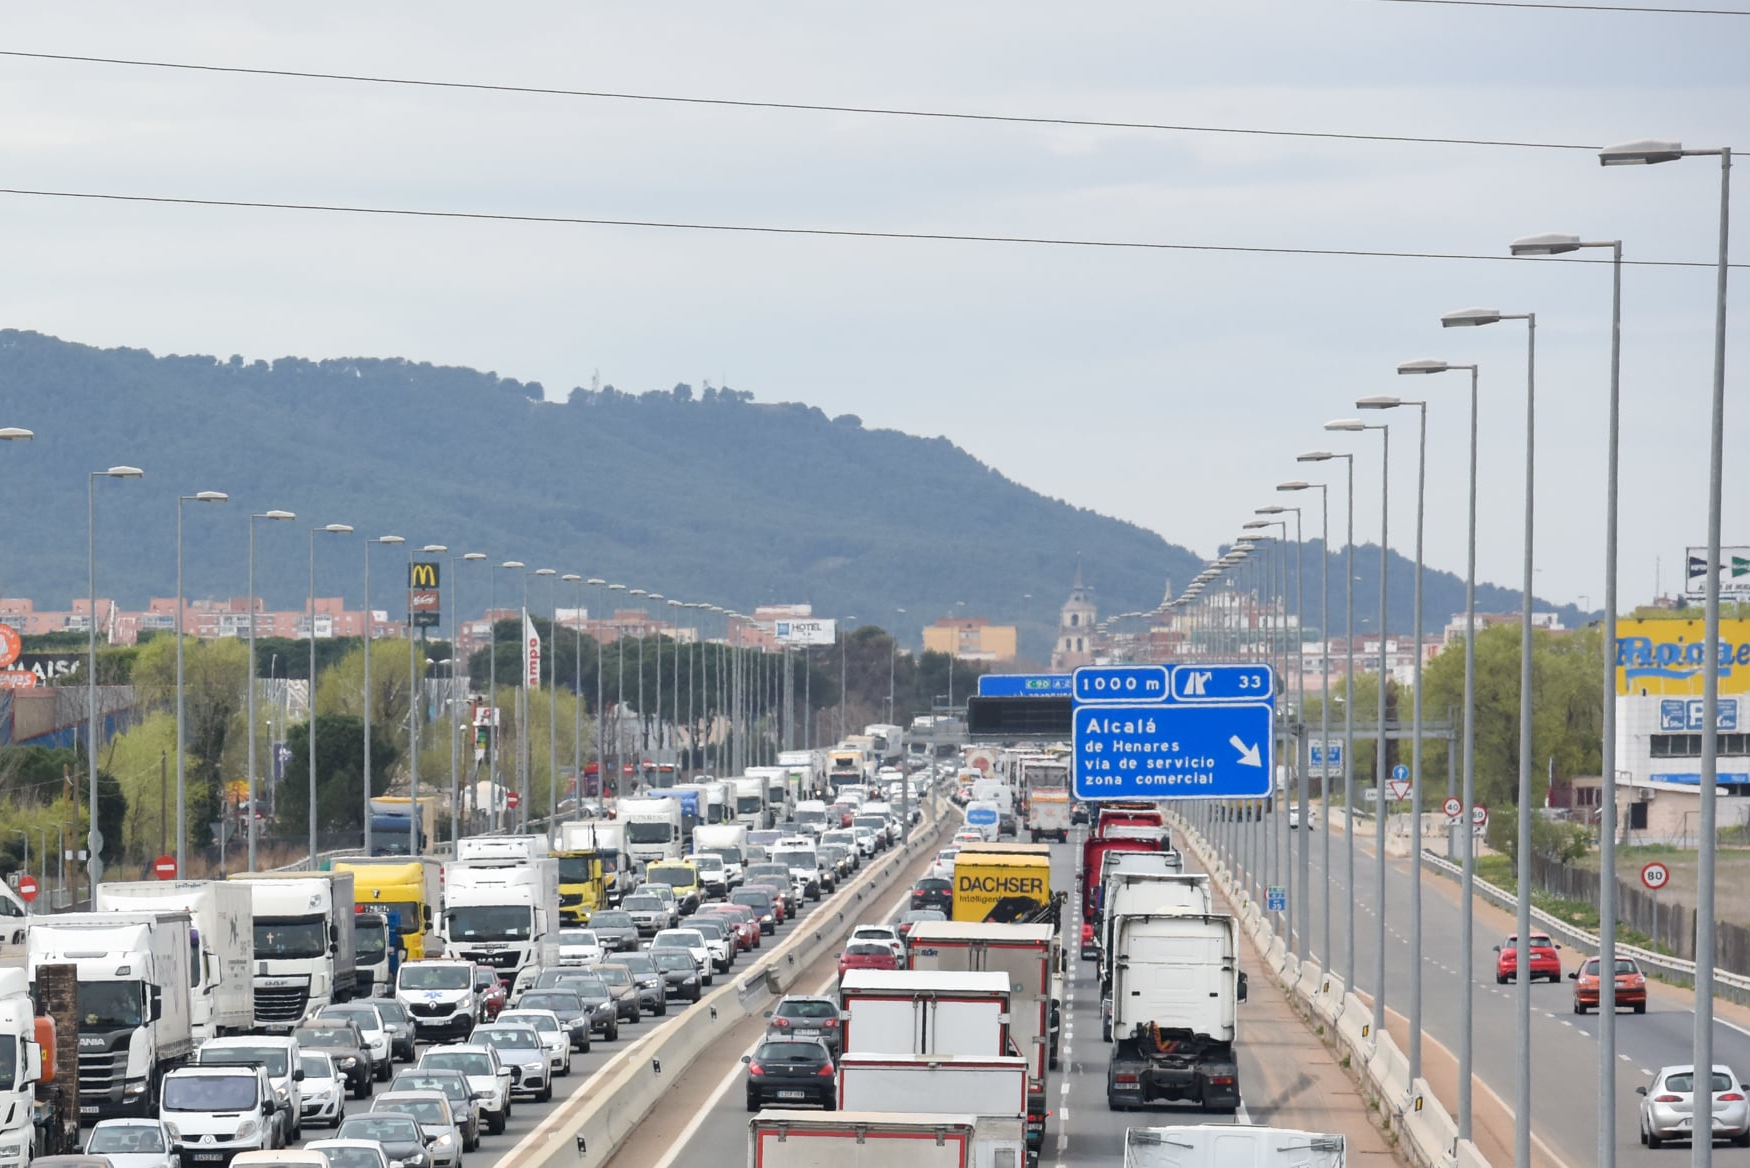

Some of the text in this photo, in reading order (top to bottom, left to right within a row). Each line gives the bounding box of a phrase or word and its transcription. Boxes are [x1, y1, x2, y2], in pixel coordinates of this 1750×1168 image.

[1083, 677, 1159, 690] 1000 m
[1239, 675, 1262, 688] 33
[1086, 717, 1157, 734] Alcalá
[1085, 740, 1180, 752] de Henares
[1119, 757, 1137, 769] de
[1147, 756, 1215, 769] servicio
[1085, 772, 1213, 785] zona comercial
[1646, 871, 1663, 880] 80
[959, 876, 1043, 894] DACHSER
